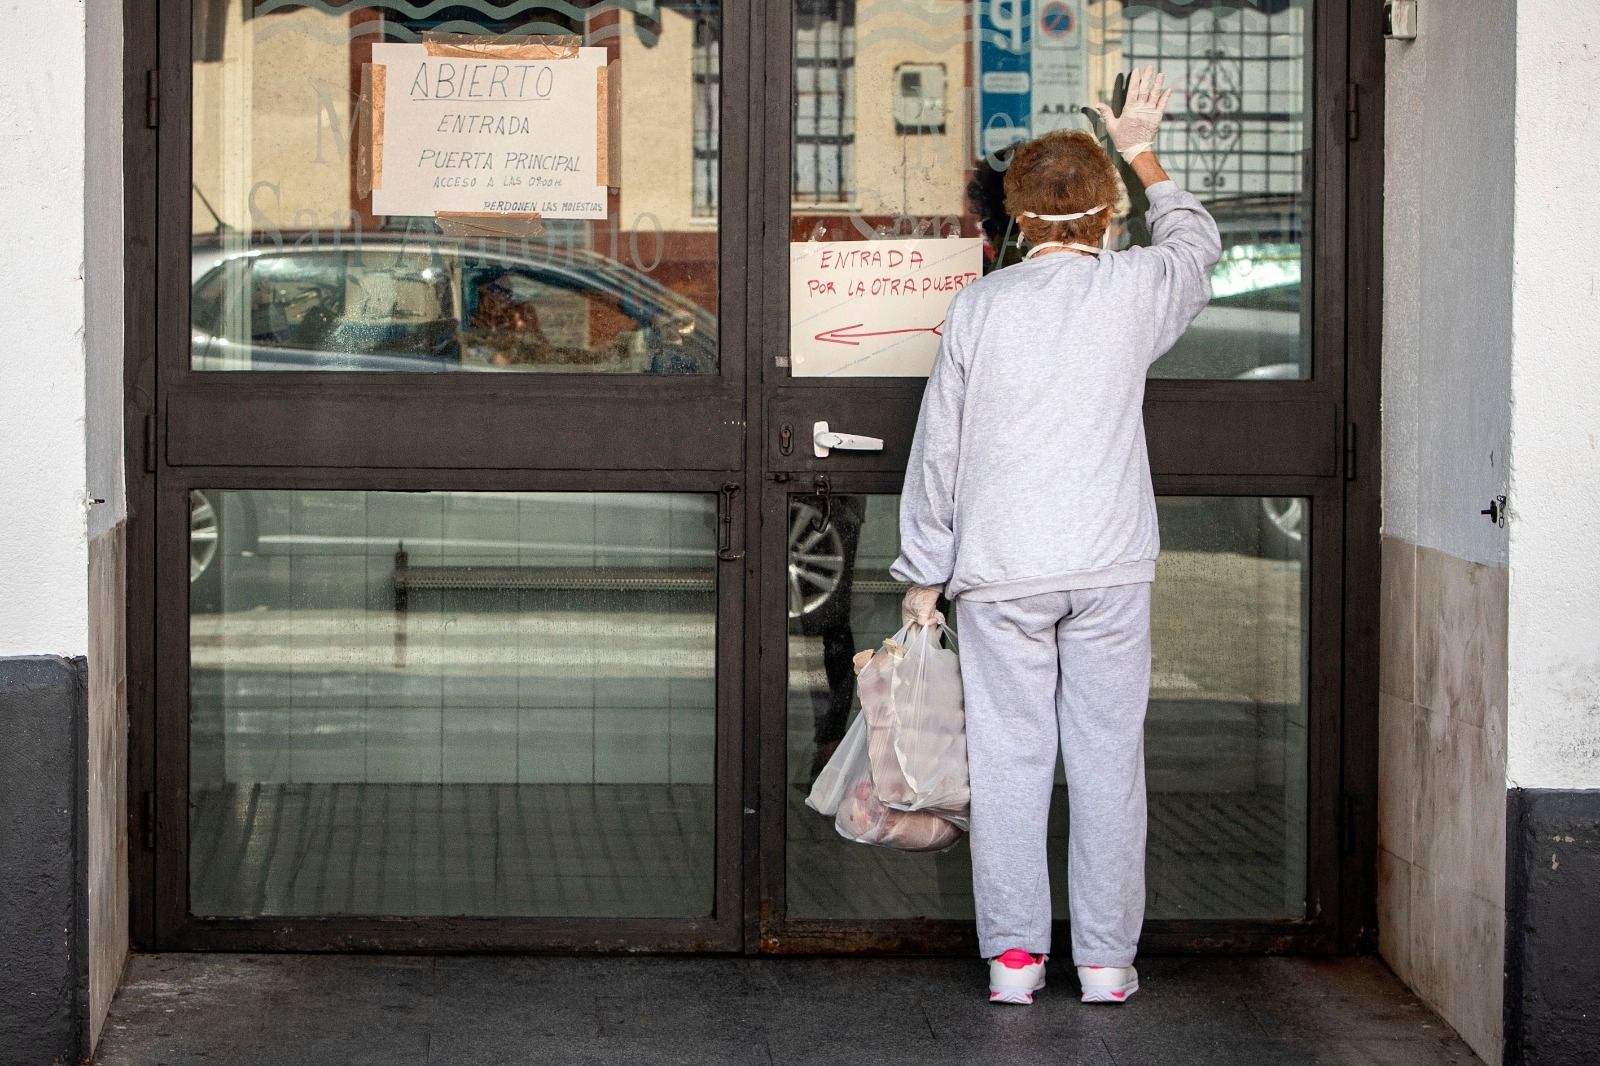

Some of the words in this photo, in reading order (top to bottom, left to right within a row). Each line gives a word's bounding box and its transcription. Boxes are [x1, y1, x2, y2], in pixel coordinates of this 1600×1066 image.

[410, 61, 554, 99] ABIERTO
[437, 114, 530, 135] ENTRADA
[418, 149, 493, 170] PUERTA
[504, 152, 581, 172] PRINCIPAL
[433, 176, 477, 188] ACCESO
[487, 176, 494, 188] A
[503, 176, 522, 187] LAS
[483, 200, 537, 212] PERDONEN
[542, 201, 558, 212] LAS
[562, 201, 603, 212] MOLESTIAS
[248, 180, 369, 270] San
[820, 249, 924, 270] ENTRADA
[807, 279, 837, 298] POR
[848, 279, 866, 297] LA
[871, 277, 917, 297] OTRA
